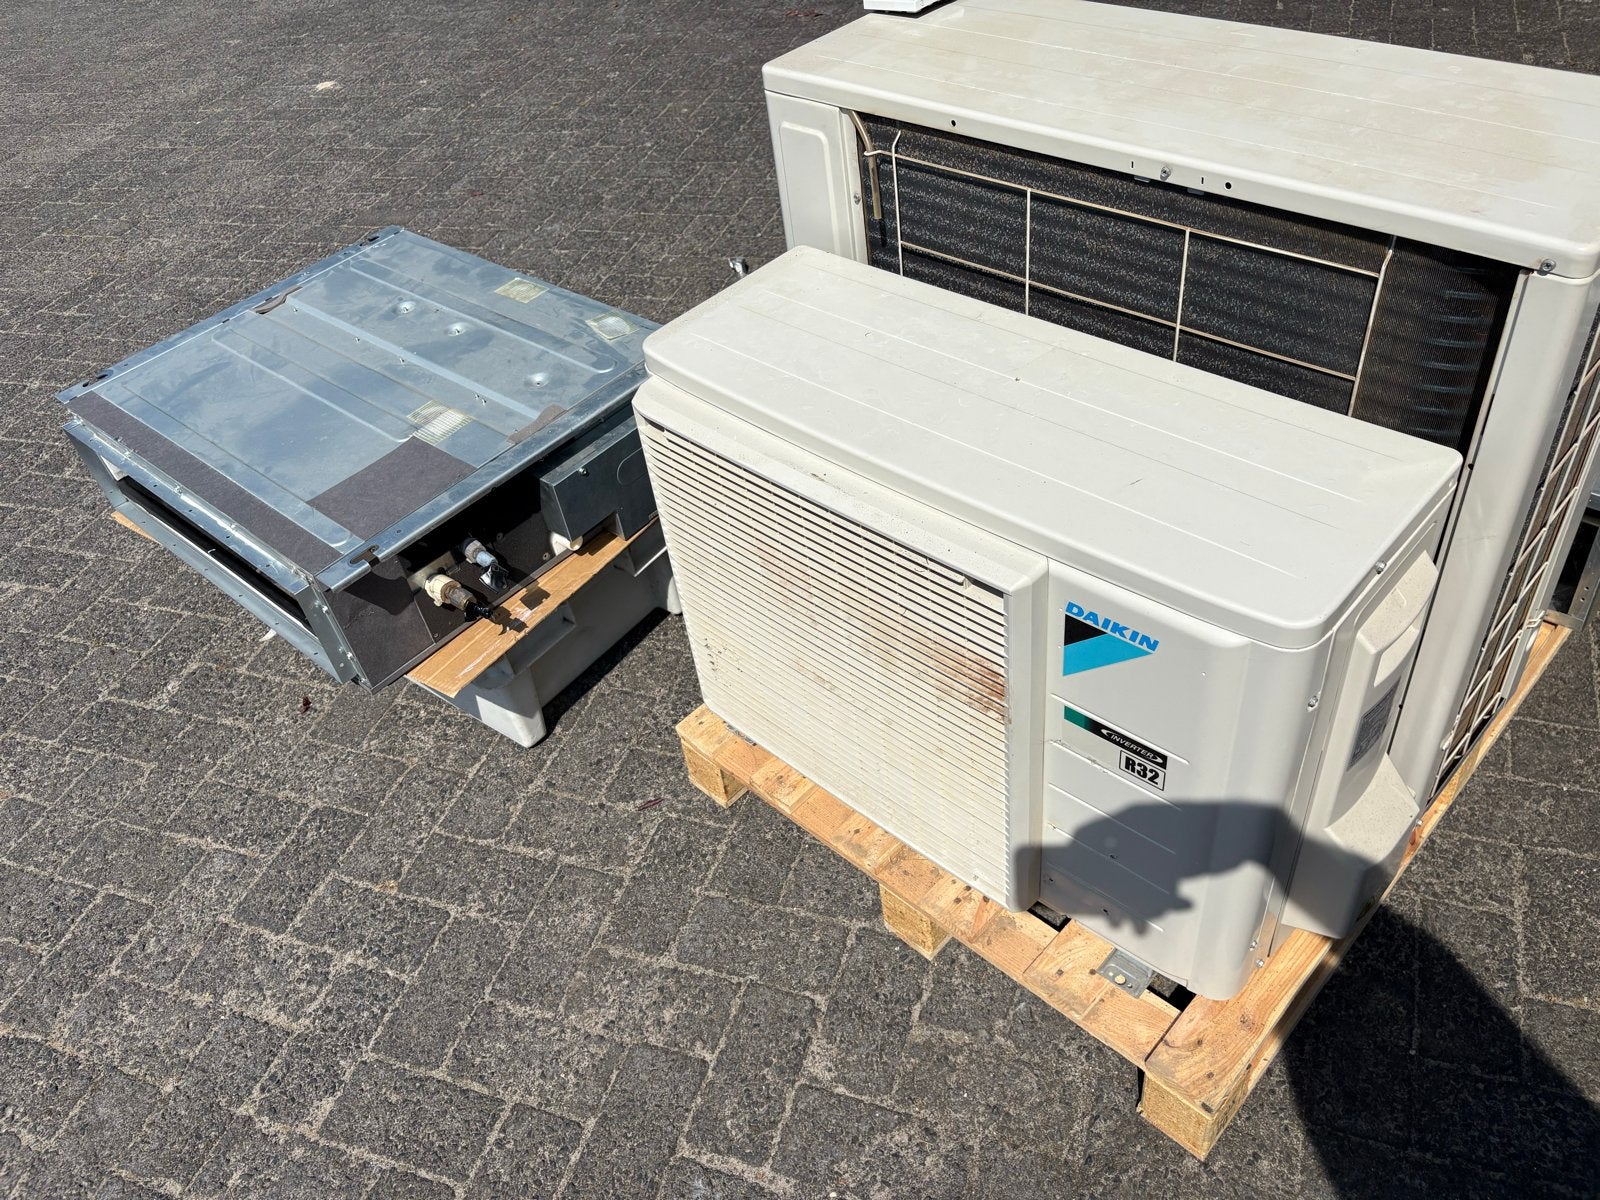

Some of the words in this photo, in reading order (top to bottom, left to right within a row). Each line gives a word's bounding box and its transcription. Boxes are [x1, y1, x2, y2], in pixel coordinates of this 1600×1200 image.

[1065, 601, 1160, 652] DAIKIN
[1110, 734, 1155, 760] INVERTER
[1124, 755, 1160, 786] R32
